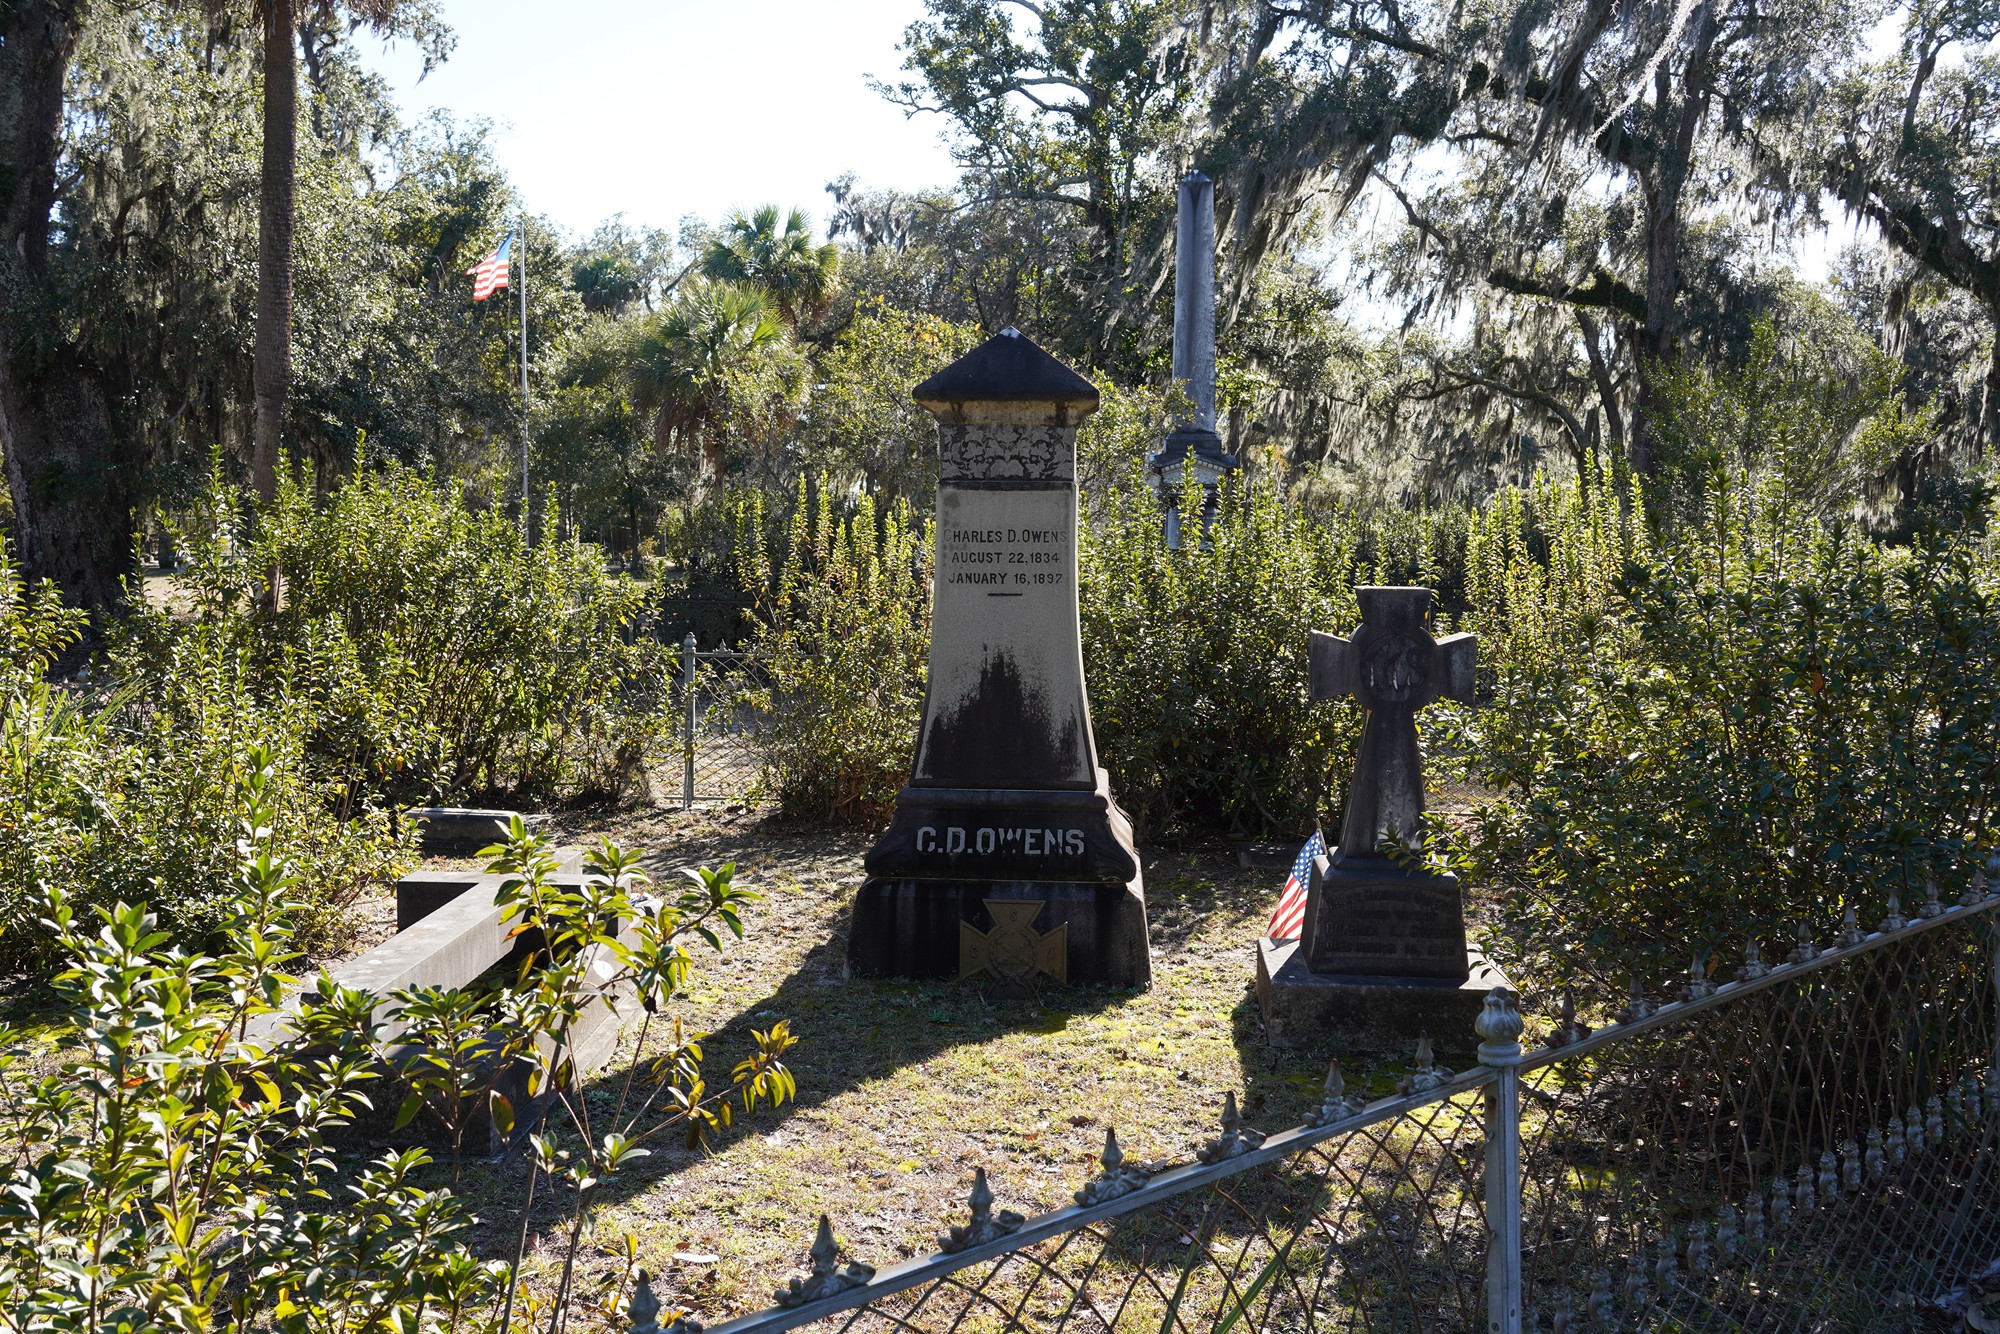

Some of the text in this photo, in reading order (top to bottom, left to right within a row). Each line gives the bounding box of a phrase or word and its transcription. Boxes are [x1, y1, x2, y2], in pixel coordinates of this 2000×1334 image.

[944, 529, 1003, 543] CHARLES
[951, 552, 1003, 563] AUGUST
[948, 572, 1008, 585] JANUARY
[1008, 908, 1018, 922] S
